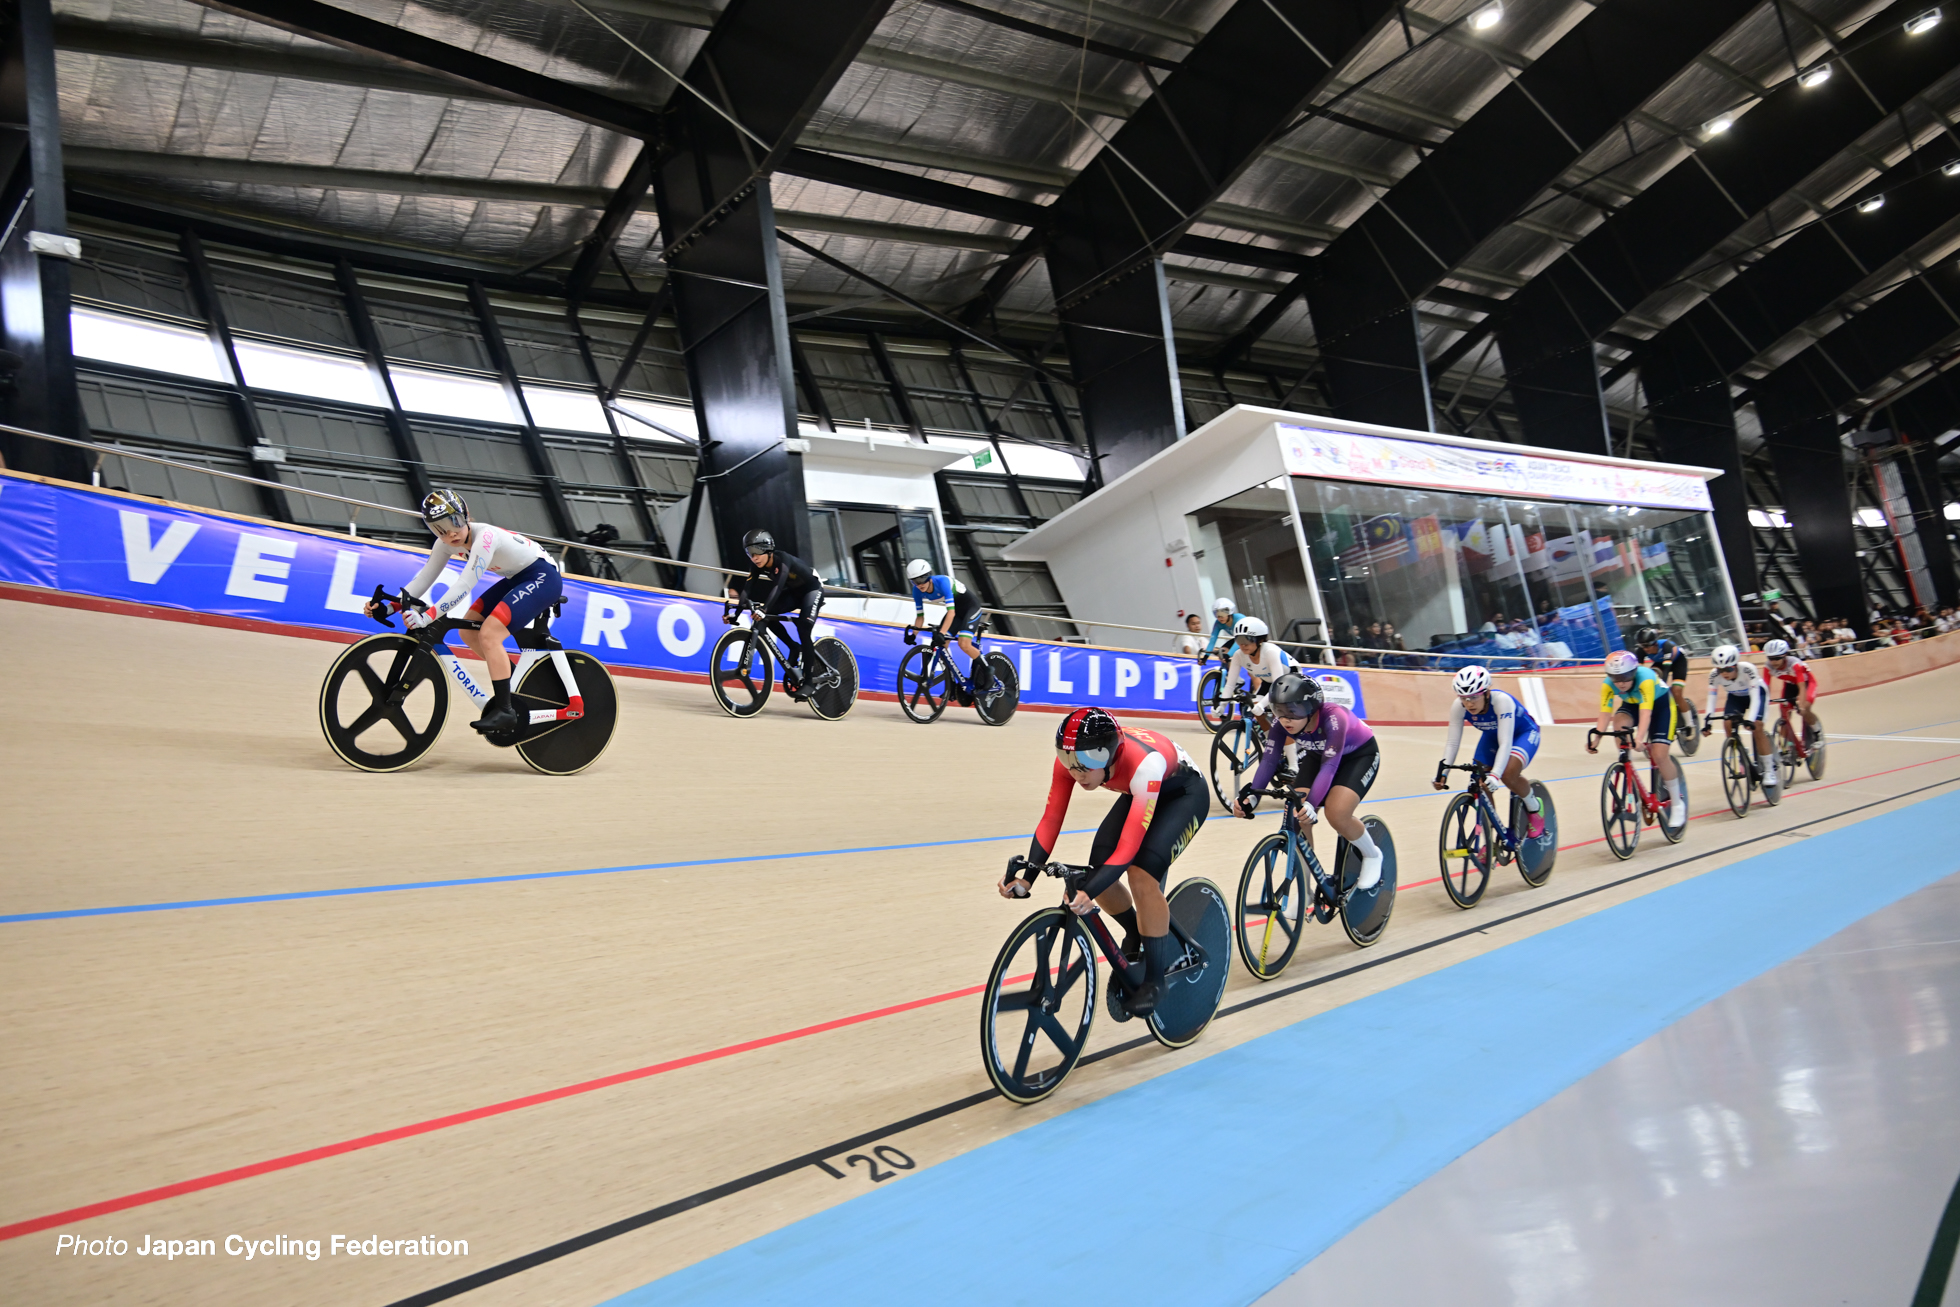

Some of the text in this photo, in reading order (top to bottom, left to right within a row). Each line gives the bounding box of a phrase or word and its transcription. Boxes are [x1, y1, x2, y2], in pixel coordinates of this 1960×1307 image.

[511, 572, 547, 605] JAPAN
[764, 634, 785, 662] ARGON
[532, 713, 555, 721] JAPAN
[1141, 798, 1157, 831] ANTA
[1170, 815, 1199, 864] CHINA
[1077, 934, 1093, 1026] CORIMA
